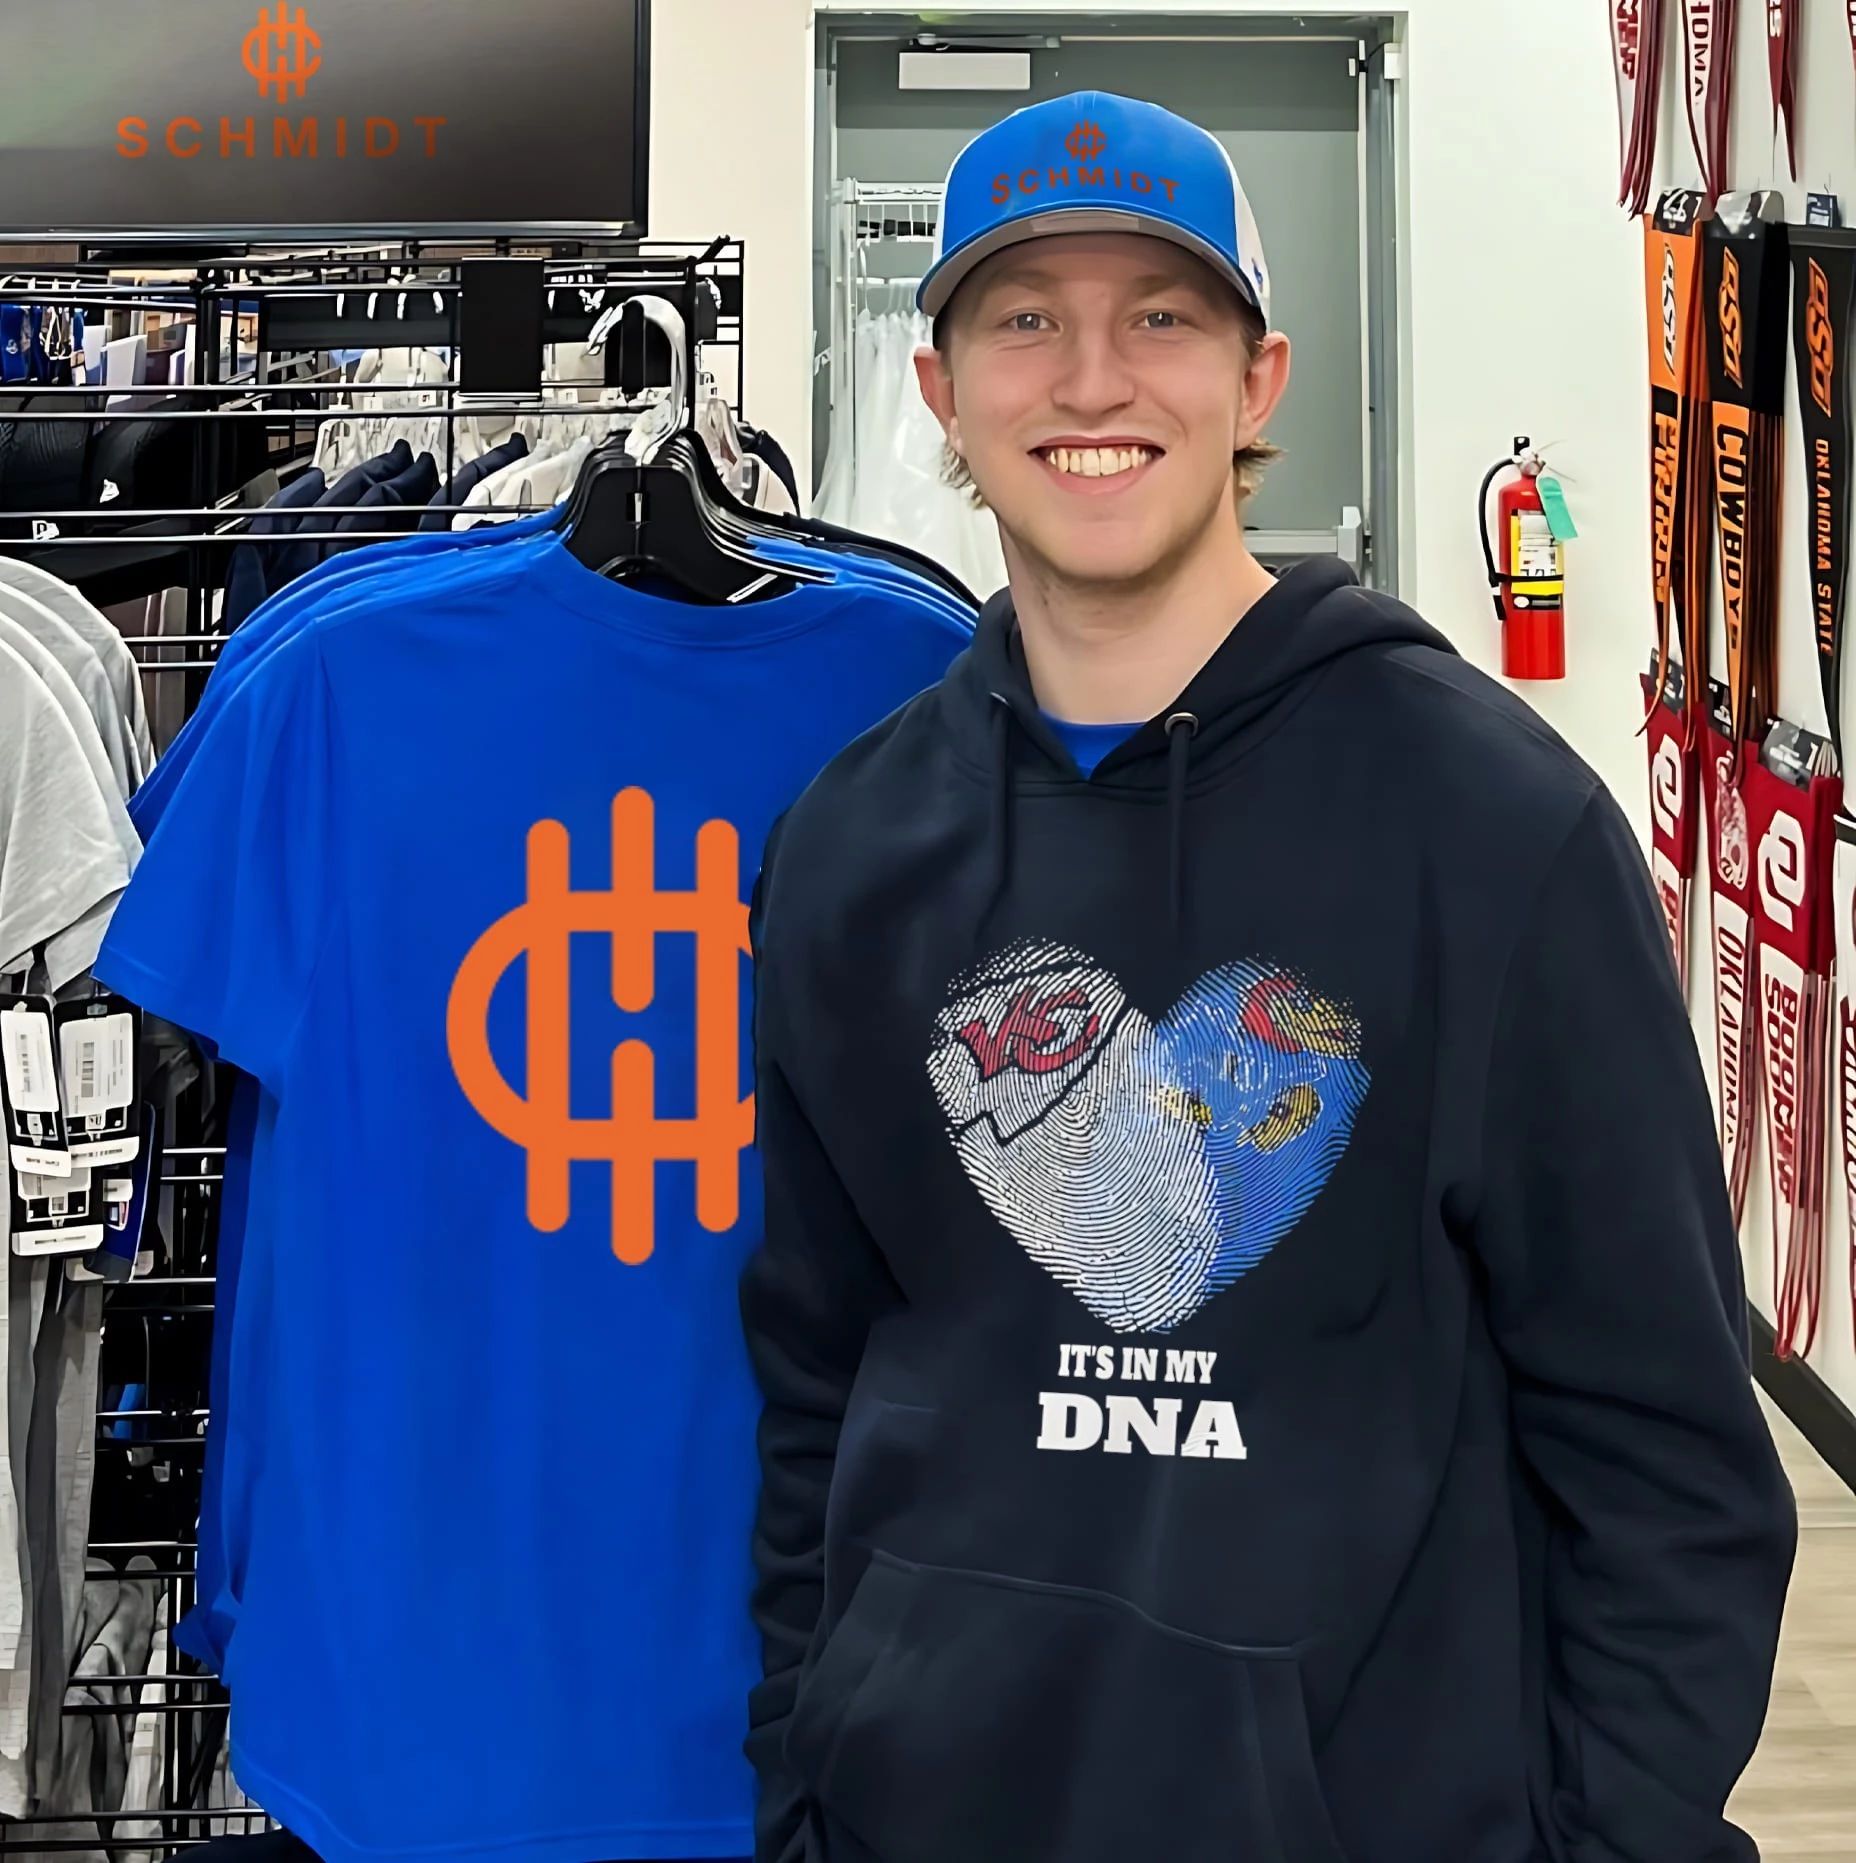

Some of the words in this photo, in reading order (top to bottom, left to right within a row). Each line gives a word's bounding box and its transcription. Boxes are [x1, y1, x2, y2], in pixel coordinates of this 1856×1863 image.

[116, 116, 447, 158] SCHMIDT
[991, 166, 1180, 205] SCHMIDT
[1815, 438, 1832, 571] OKLAHOMA
[1718, 926, 1746, 1145] OKLAHOMA
[1776, 983, 1798, 1204] BOOM
[1057, 1343, 1115, 1381] IT'S
[1120, 1346, 1159, 1382] IN
[1163, 1349, 1218, 1385] MY
[1036, 1391, 1248, 1460] DNA
